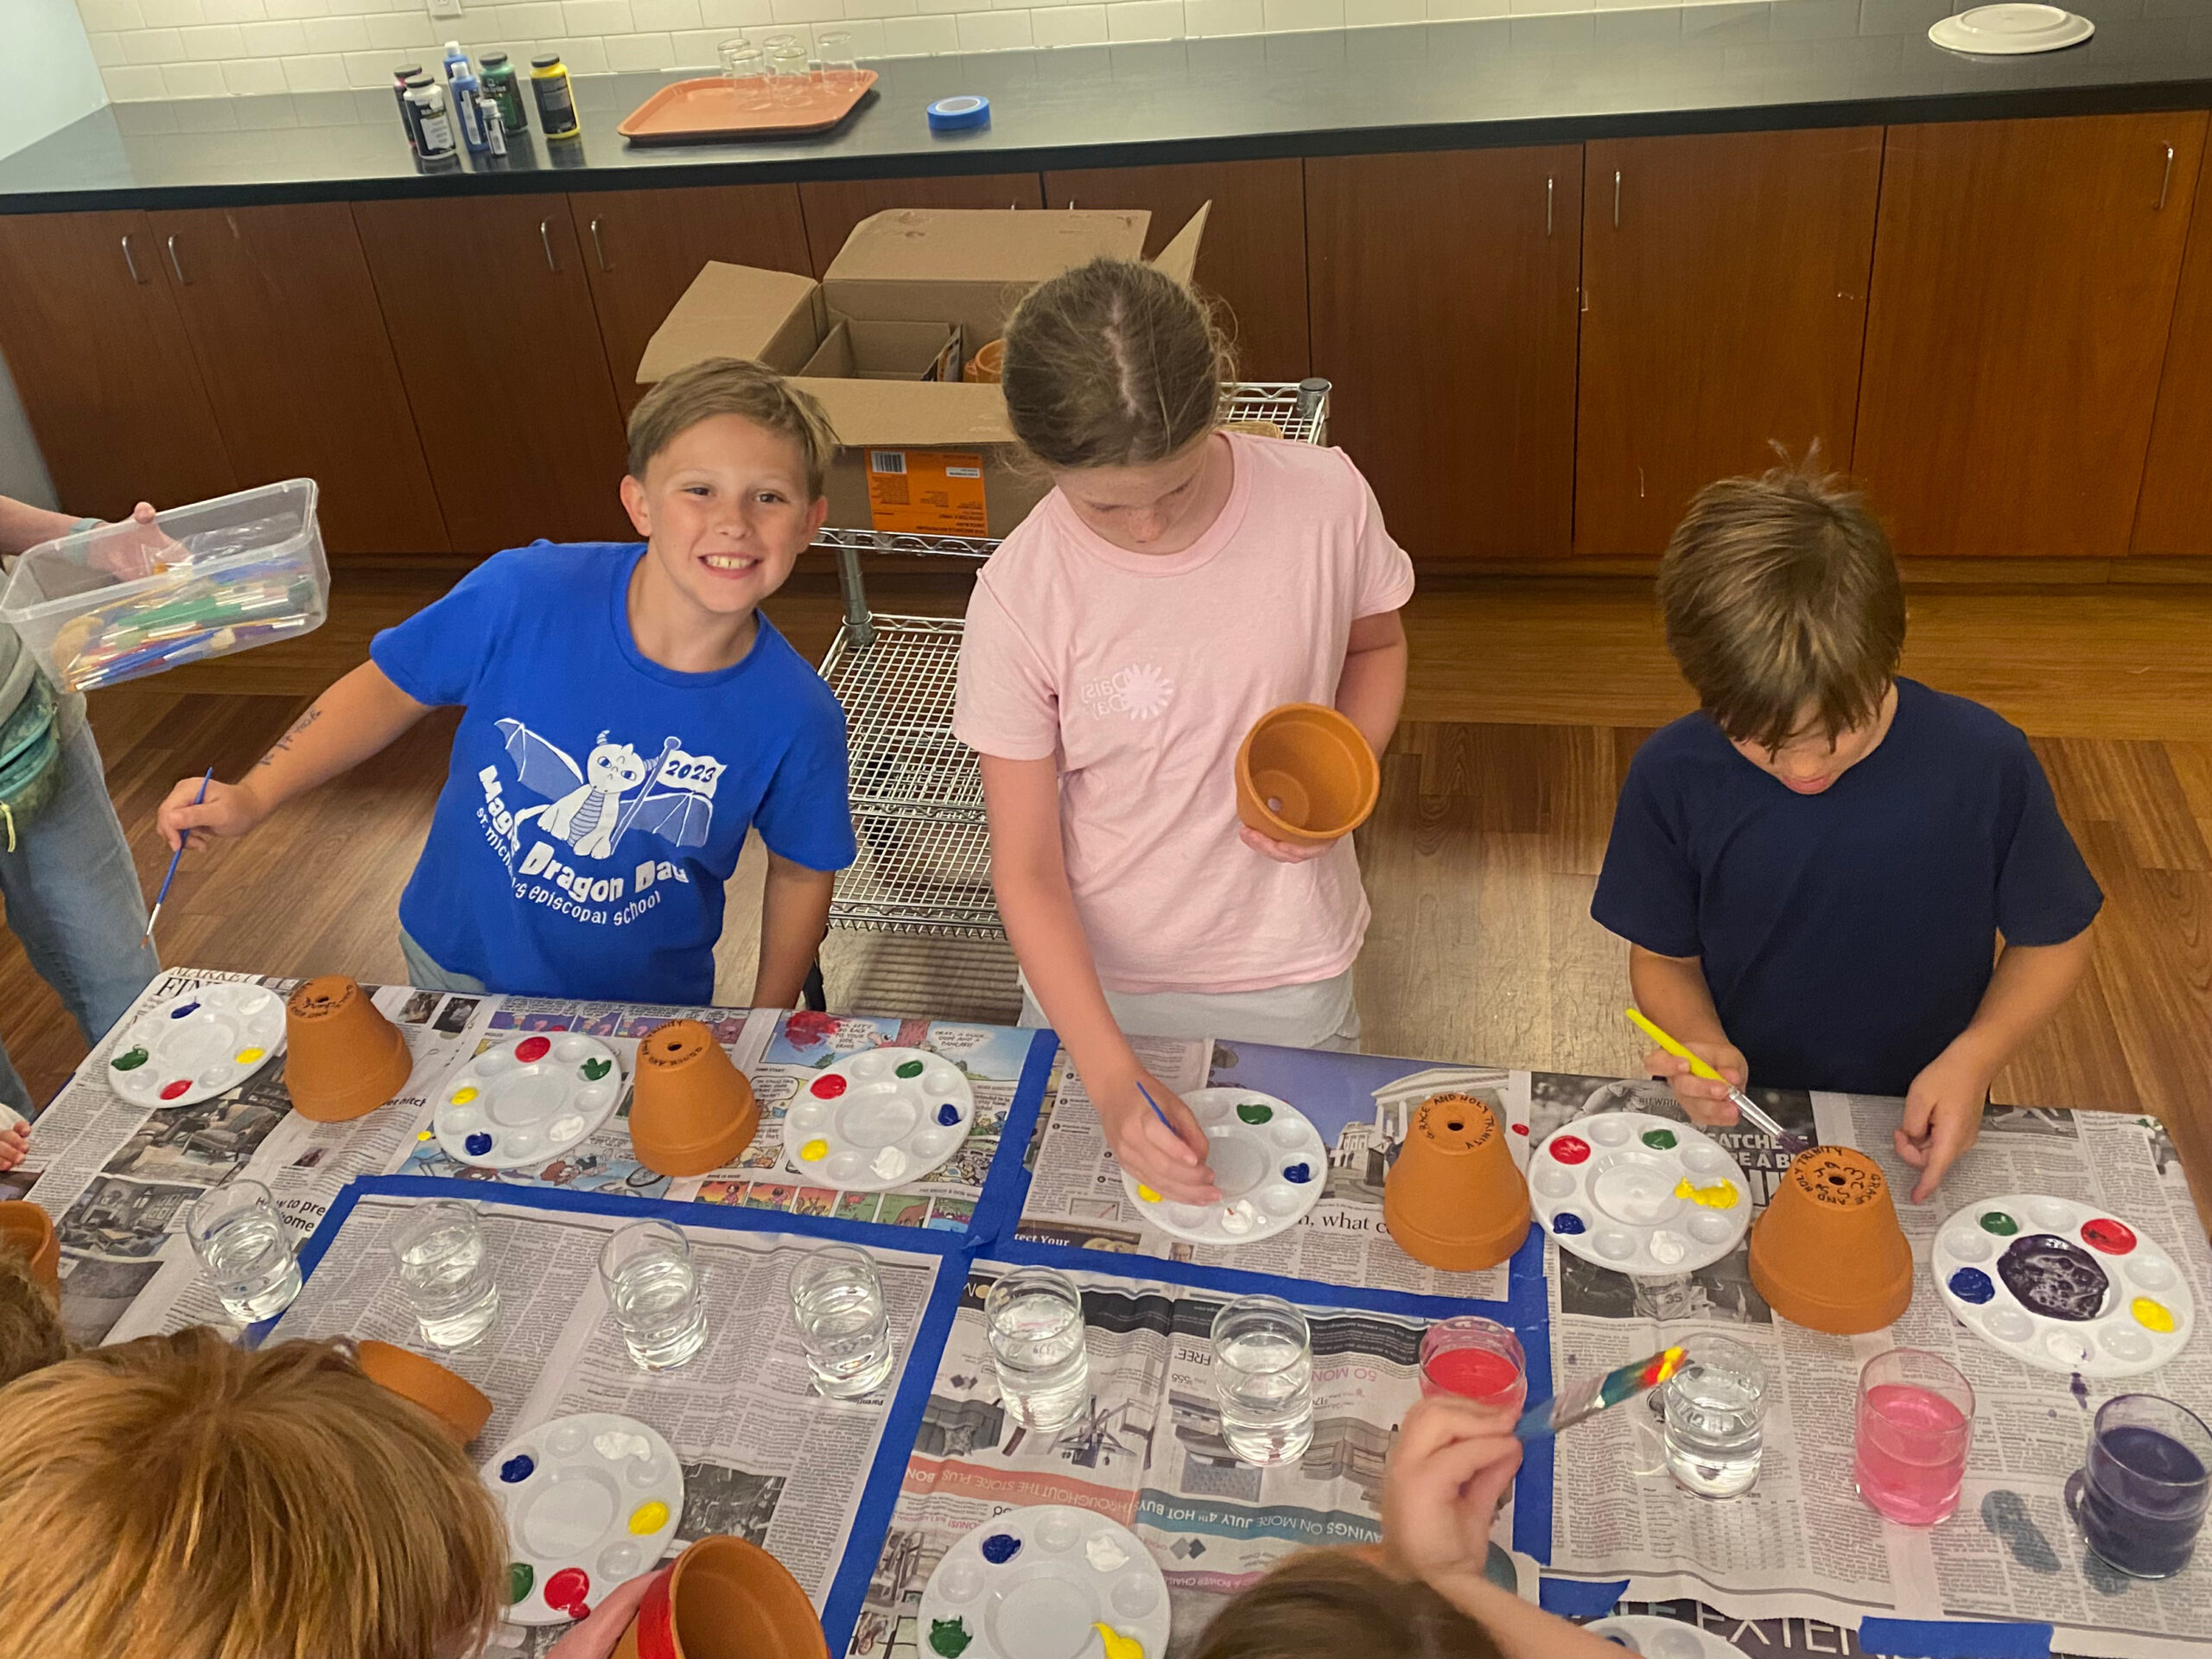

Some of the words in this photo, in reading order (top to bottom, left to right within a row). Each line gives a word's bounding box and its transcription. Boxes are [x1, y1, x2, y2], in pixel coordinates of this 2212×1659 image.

[664, 760, 715, 783] 2023
[518, 840, 625, 904] Dragon
[1459, 1095, 1489, 1115] HOLY
[1418, 1106, 1435, 1140] GRACE
[1465, 1115, 1495, 1150] TRINITY
[1796, 1145, 1843, 1166] TRINITY
[1794, 1166, 1814, 1192] HOLY
[1853, 1173, 1882, 1205] GRACE
[1817, 1193, 1847, 1206] AND
[1322, 1211, 1370, 1230] what
[1040, 1236, 1071, 1247] Your
[1665, 1292, 1683, 1305] 35
[941, 1469, 972, 1484] PLUS
[1017, 1481, 1040, 1496] THE
[1167, 1508, 1196, 1522] HOT
[1220, 1513, 1255, 1529] JULY
[1255, 1514, 1297, 1529] MORE
[1299, 1521, 1323, 1535] ON
[1197, 1577, 1231, 1588] POWER
